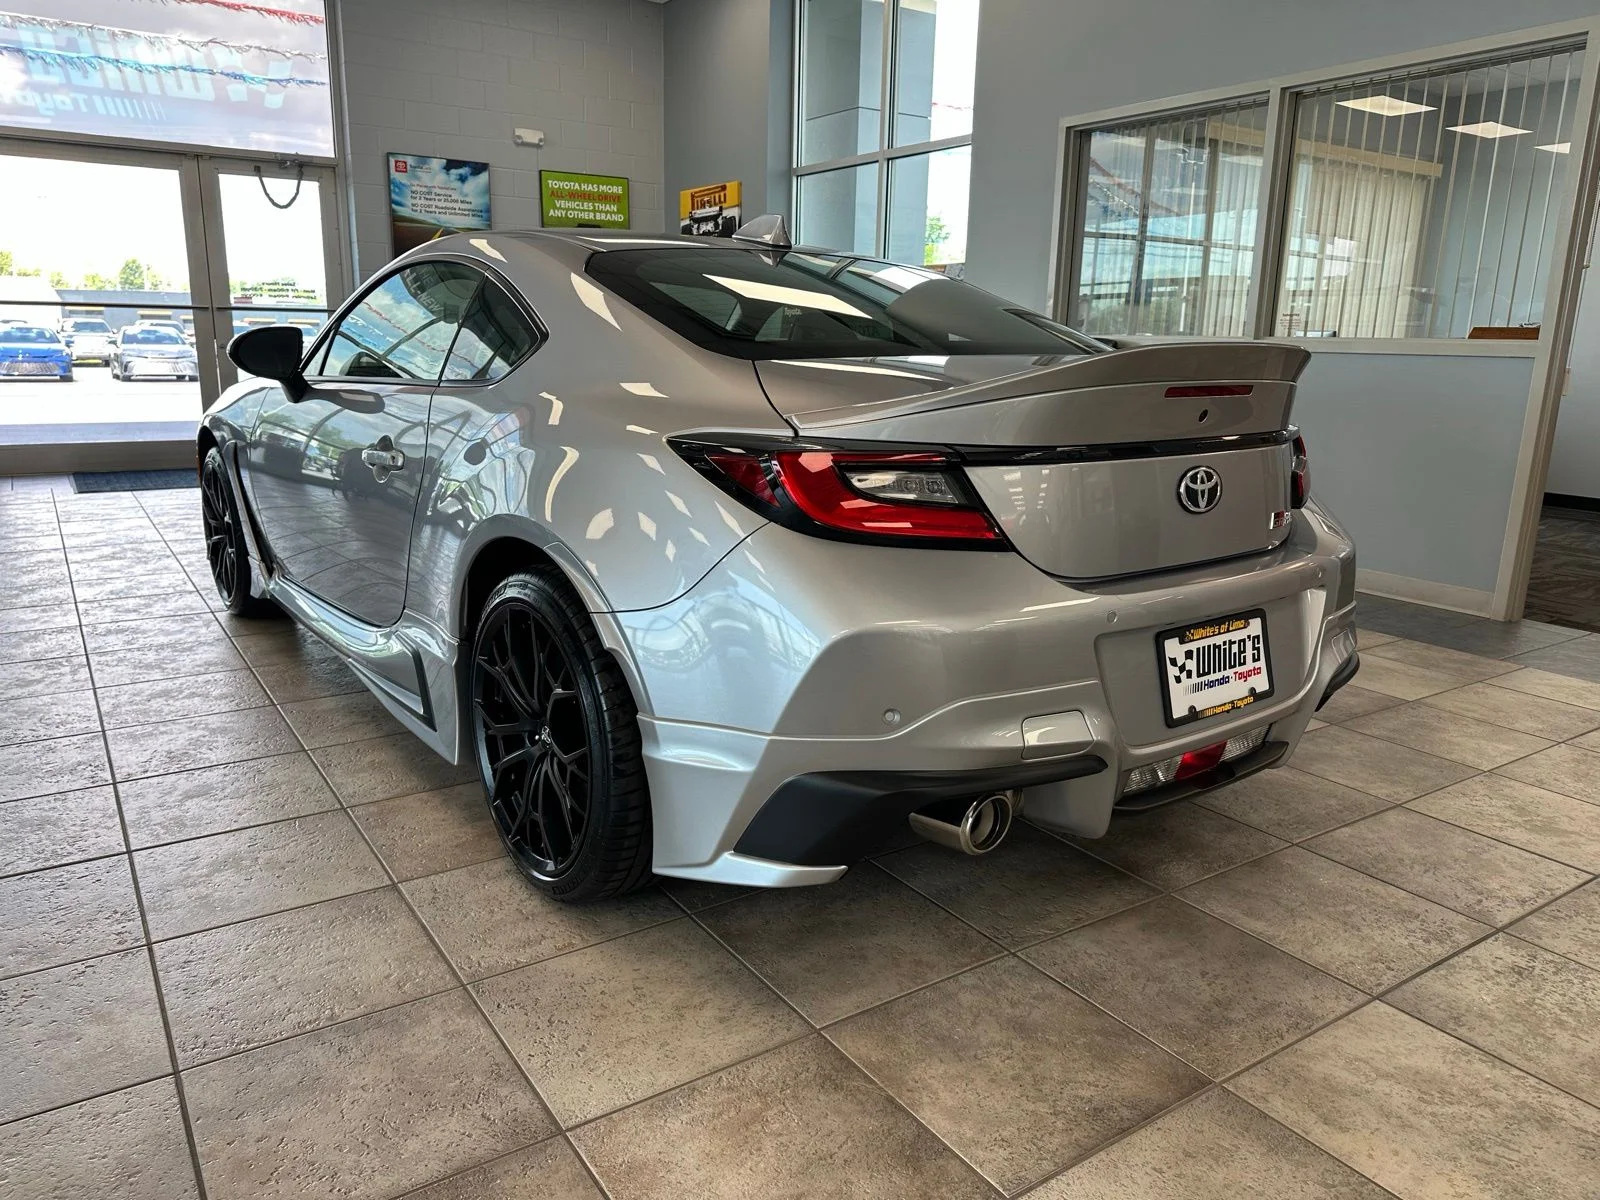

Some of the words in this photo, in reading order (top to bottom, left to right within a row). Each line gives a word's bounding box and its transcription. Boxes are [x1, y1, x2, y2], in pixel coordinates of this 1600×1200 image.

[547, 180, 580, 190] TOYOTA
[581, 183, 598, 192] HAS
[599, 185, 623, 193] MORE
[550, 190, 596, 200] ALL-WHEEL
[598, 194, 622, 203] DRIVE
[555, 200, 593, 210] VEHICLES
[594, 203, 617, 212] THAN
[549, 209, 566, 217] ANY
[568, 211, 594, 220] OTHER
[596, 213, 624, 221] BRAND
[1194, 624, 1219, 640] White's
[1220, 622, 1228, 632] of
[1229, 620, 1245, 630] Lima
[1196, 634, 1260, 678] White's
[1204, 675, 1230, 690] Honda
[1233, 666, 1261, 682] Toyota
[1213, 703, 1232, 715] Honda
[1234, 696, 1253, 708] Toyota
